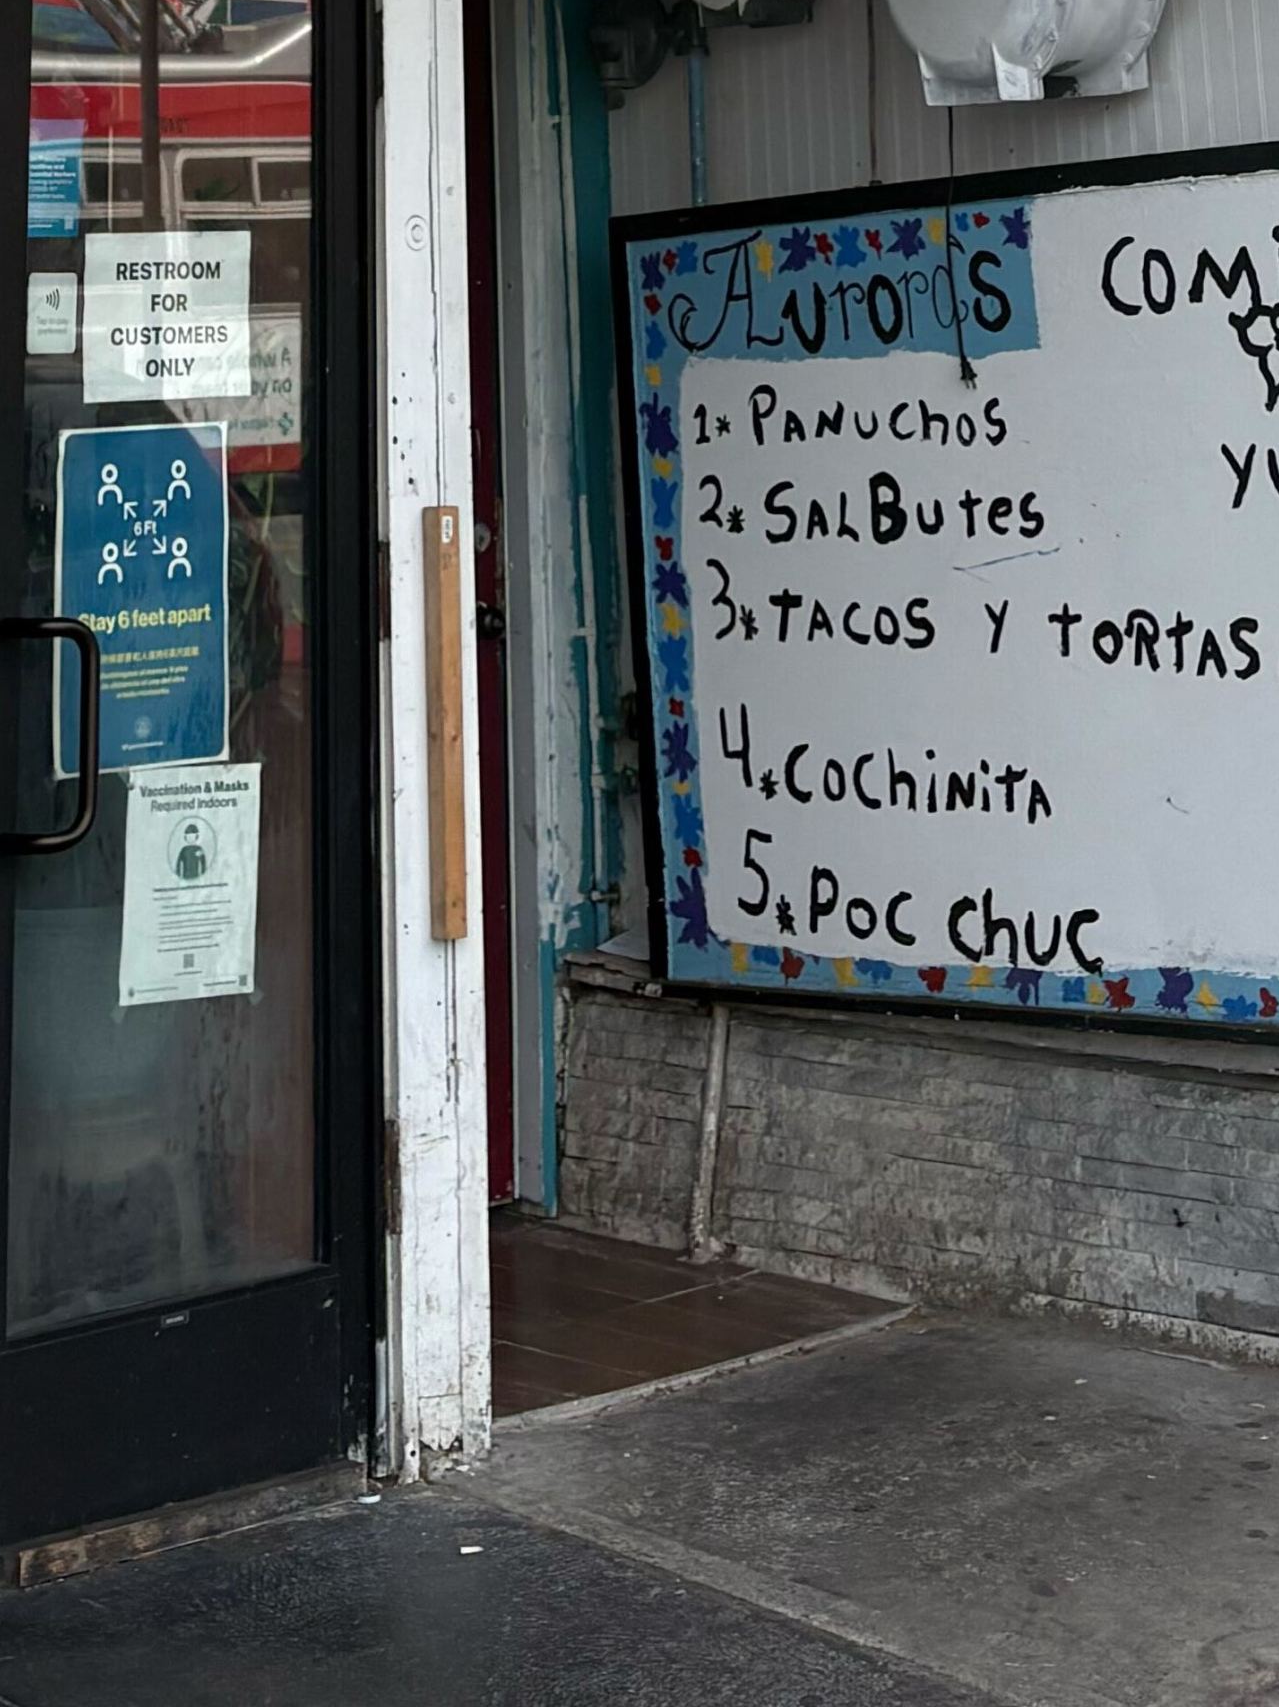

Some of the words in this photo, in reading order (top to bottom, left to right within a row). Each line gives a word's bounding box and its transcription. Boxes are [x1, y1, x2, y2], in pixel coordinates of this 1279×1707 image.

[116, 261, 221, 281] RESTROOM
[151, 293, 188, 312] FOR
[111, 325, 228, 346] CUSTOMERS
[145, 358, 195, 378] ONLY
[133, 521, 142, 536] 6
[78, 613, 115, 634] Stay
[118, 610, 130, 629] 6
[132, 608, 165, 627] feet
[167, 603, 211, 628] apart
[140, 783, 201, 797] Vaccination
[214, 780, 249, 793] Masks
[150, 798, 195, 813] Required
[197, 796, 237, 810] Indoors
